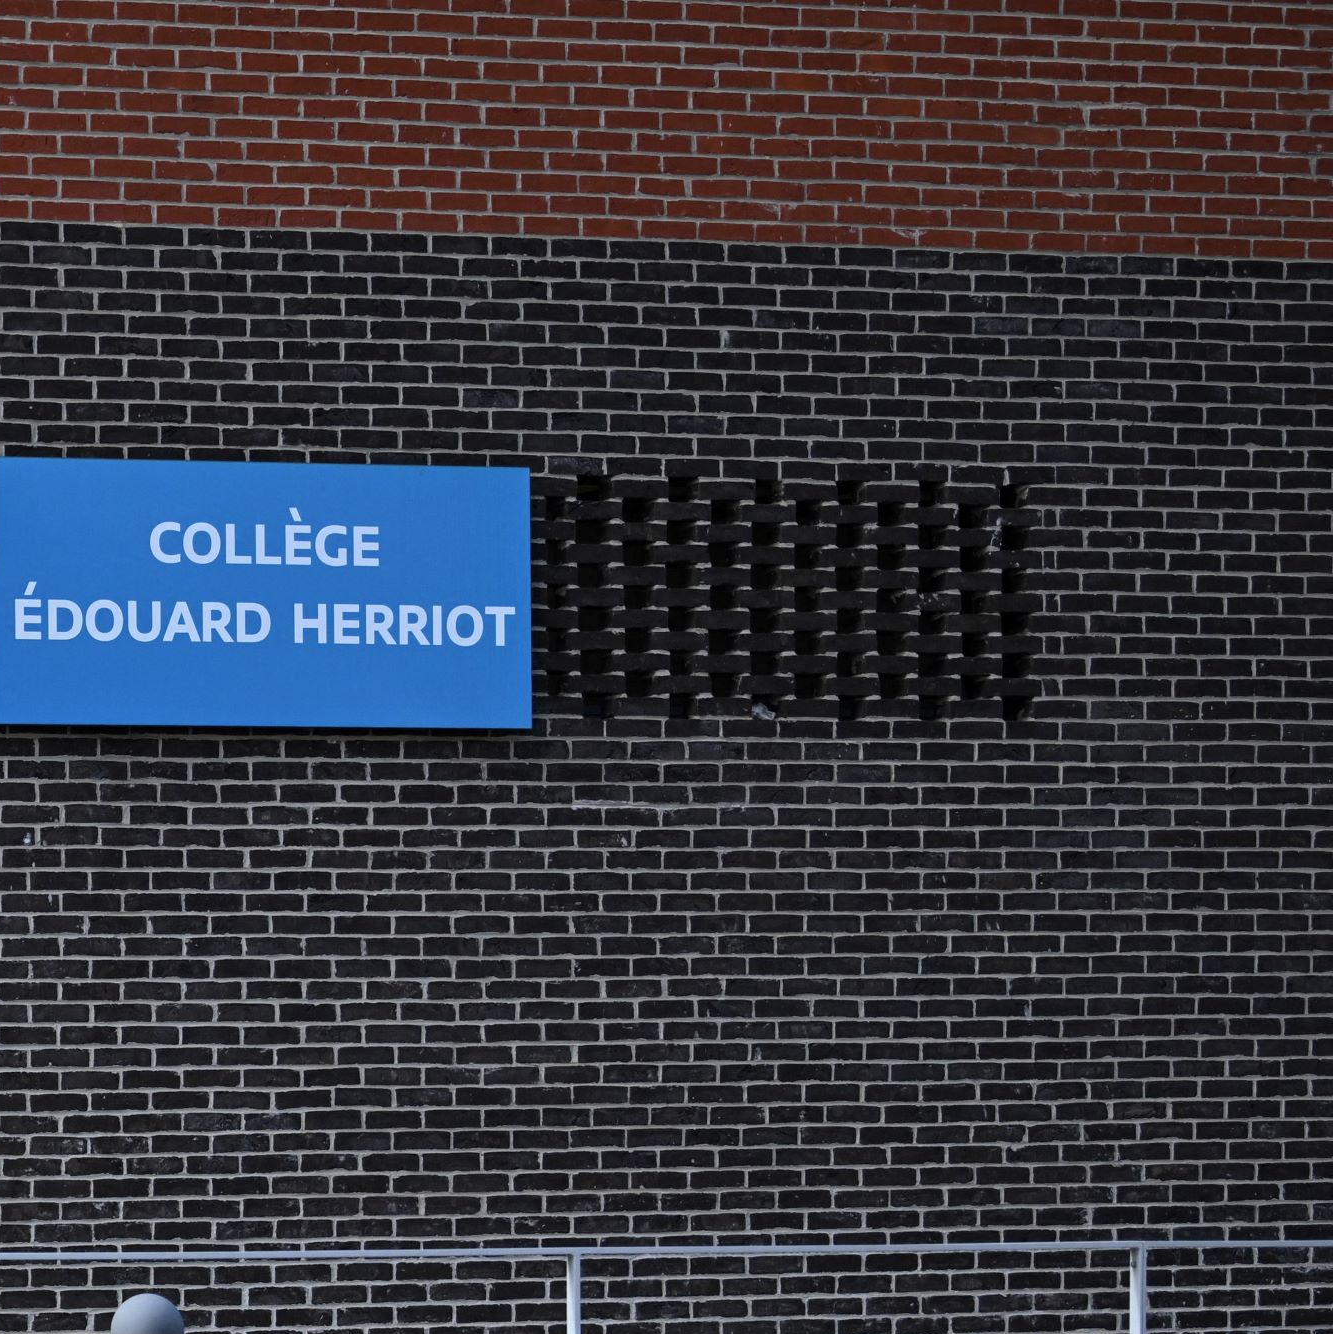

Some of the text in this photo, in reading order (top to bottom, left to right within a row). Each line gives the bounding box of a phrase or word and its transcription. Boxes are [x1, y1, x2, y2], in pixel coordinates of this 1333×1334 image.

[149, 507, 380, 567] COLLÈGE
[14, 581, 516, 647] ÉDOUARD HERRIOT
